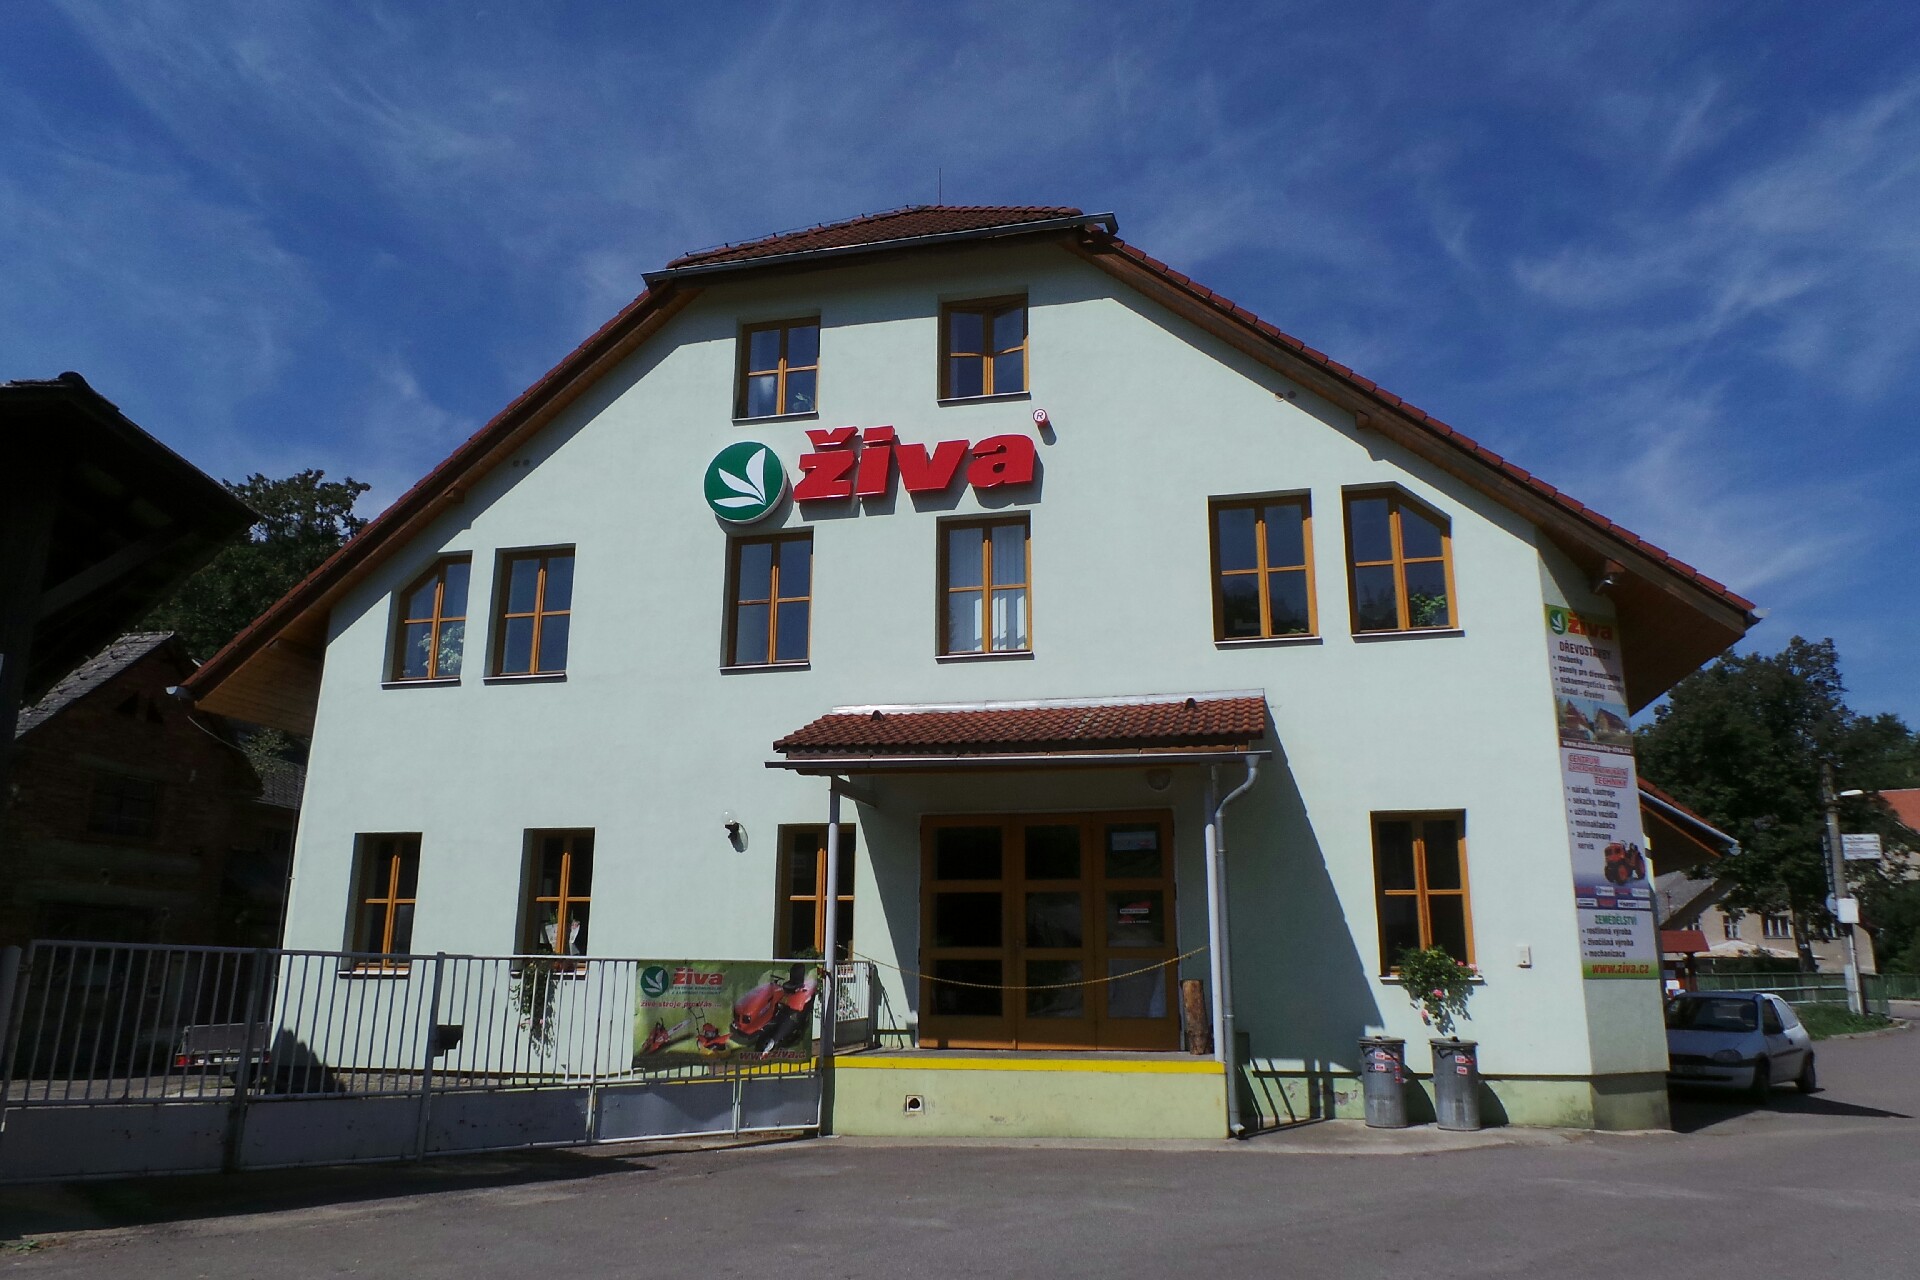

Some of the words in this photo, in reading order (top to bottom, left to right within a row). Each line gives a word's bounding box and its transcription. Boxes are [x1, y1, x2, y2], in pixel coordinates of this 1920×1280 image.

[793, 425, 1036, 503] živa
[1567, 611, 1613, 640] živa
[1559, 640, 1611, 660] DŘEVOSTAVBY
[672, 967, 724, 986] živa
[658, 1001, 681, 1009] stroje
